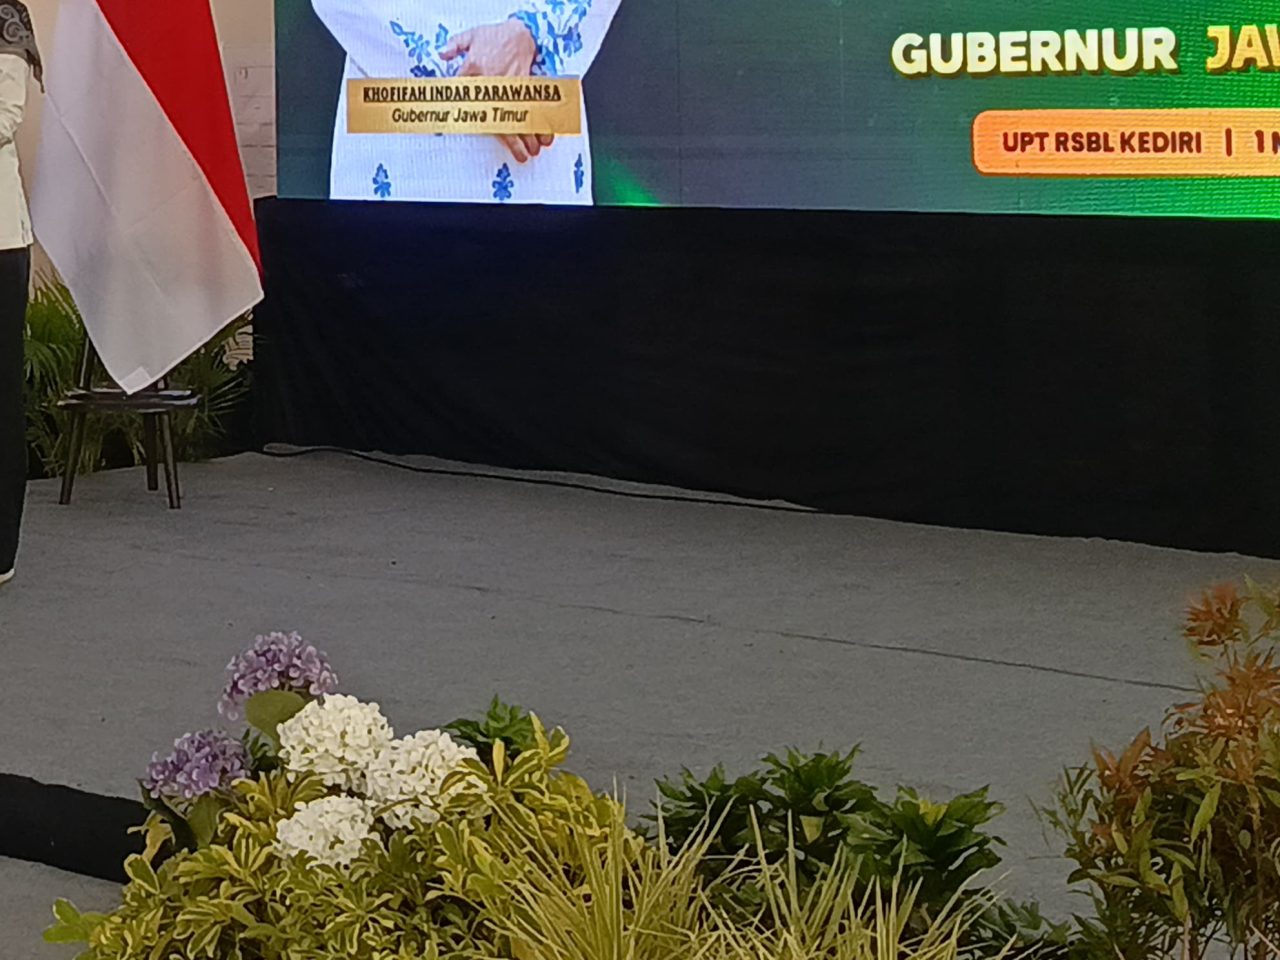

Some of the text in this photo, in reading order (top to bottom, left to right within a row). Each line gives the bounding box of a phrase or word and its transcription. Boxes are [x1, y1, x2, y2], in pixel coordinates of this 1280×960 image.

[891, 26, 1179, 75] GUBERNUR
[362, 84, 562, 103] KHOFIFAH INDAR PARAWANSA
[392, 107, 529, 123] Gubernur Jawa Timur
[1001, 131, 1051, 154] UPT
[1054, 130, 1116, 154] RSBL
[1120, 130, 1203, 154] KEDIRI
